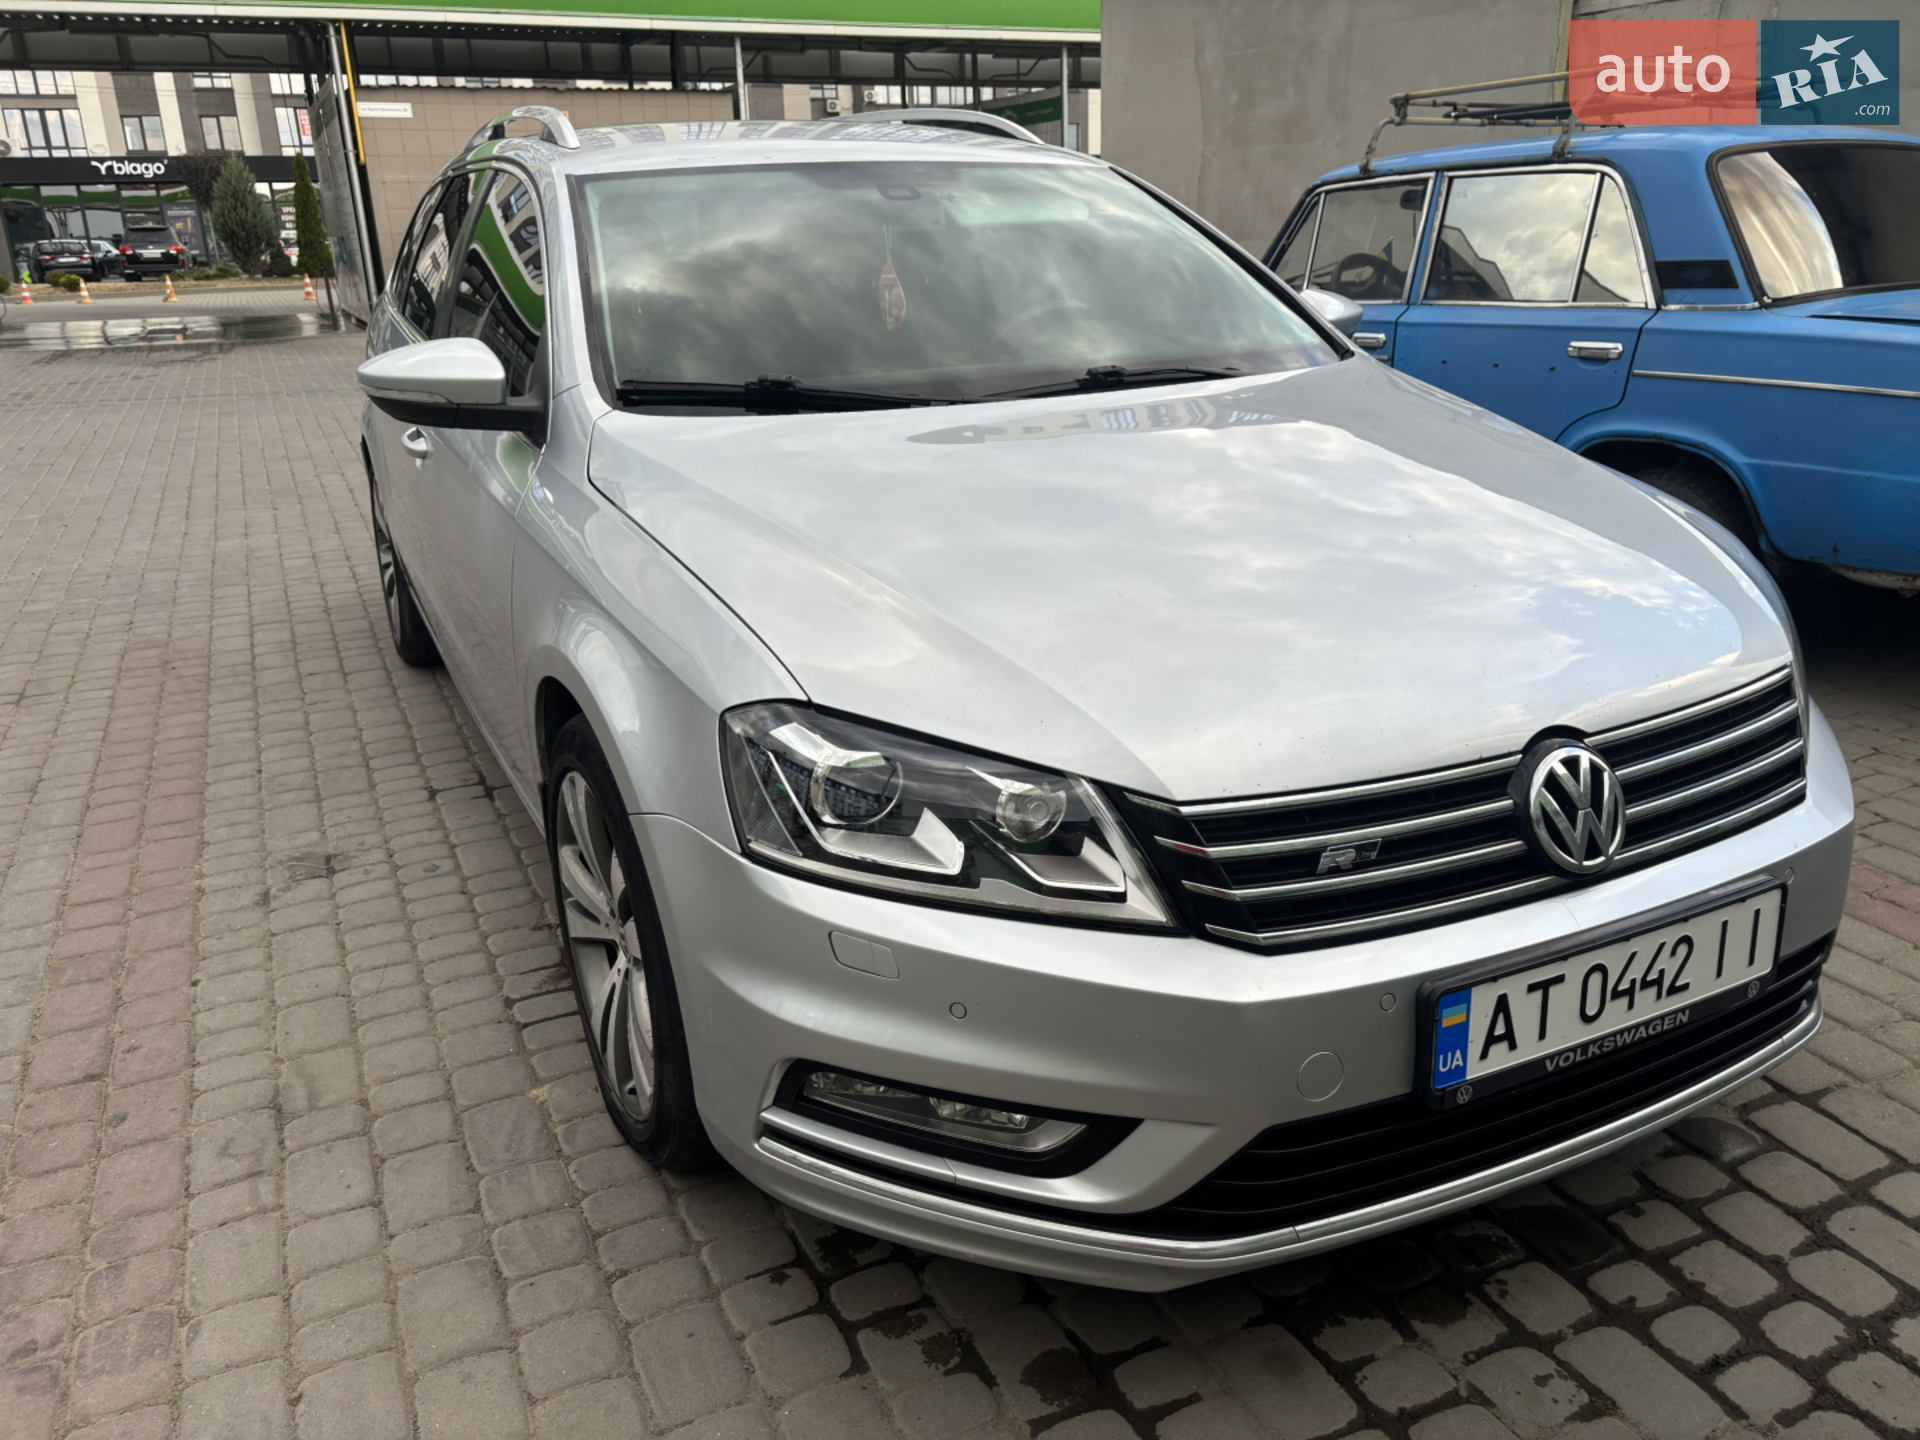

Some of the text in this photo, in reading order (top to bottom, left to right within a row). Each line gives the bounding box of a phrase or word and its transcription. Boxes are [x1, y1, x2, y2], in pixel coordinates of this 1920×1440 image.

[1478, 973, 1566, 1061] AT
[1579, 934, 1695, 1024] 0442
[1438, 1049, 1464, 1073] UA
[1544, 1008, 1690, 1072] VOLKSWAGEN
